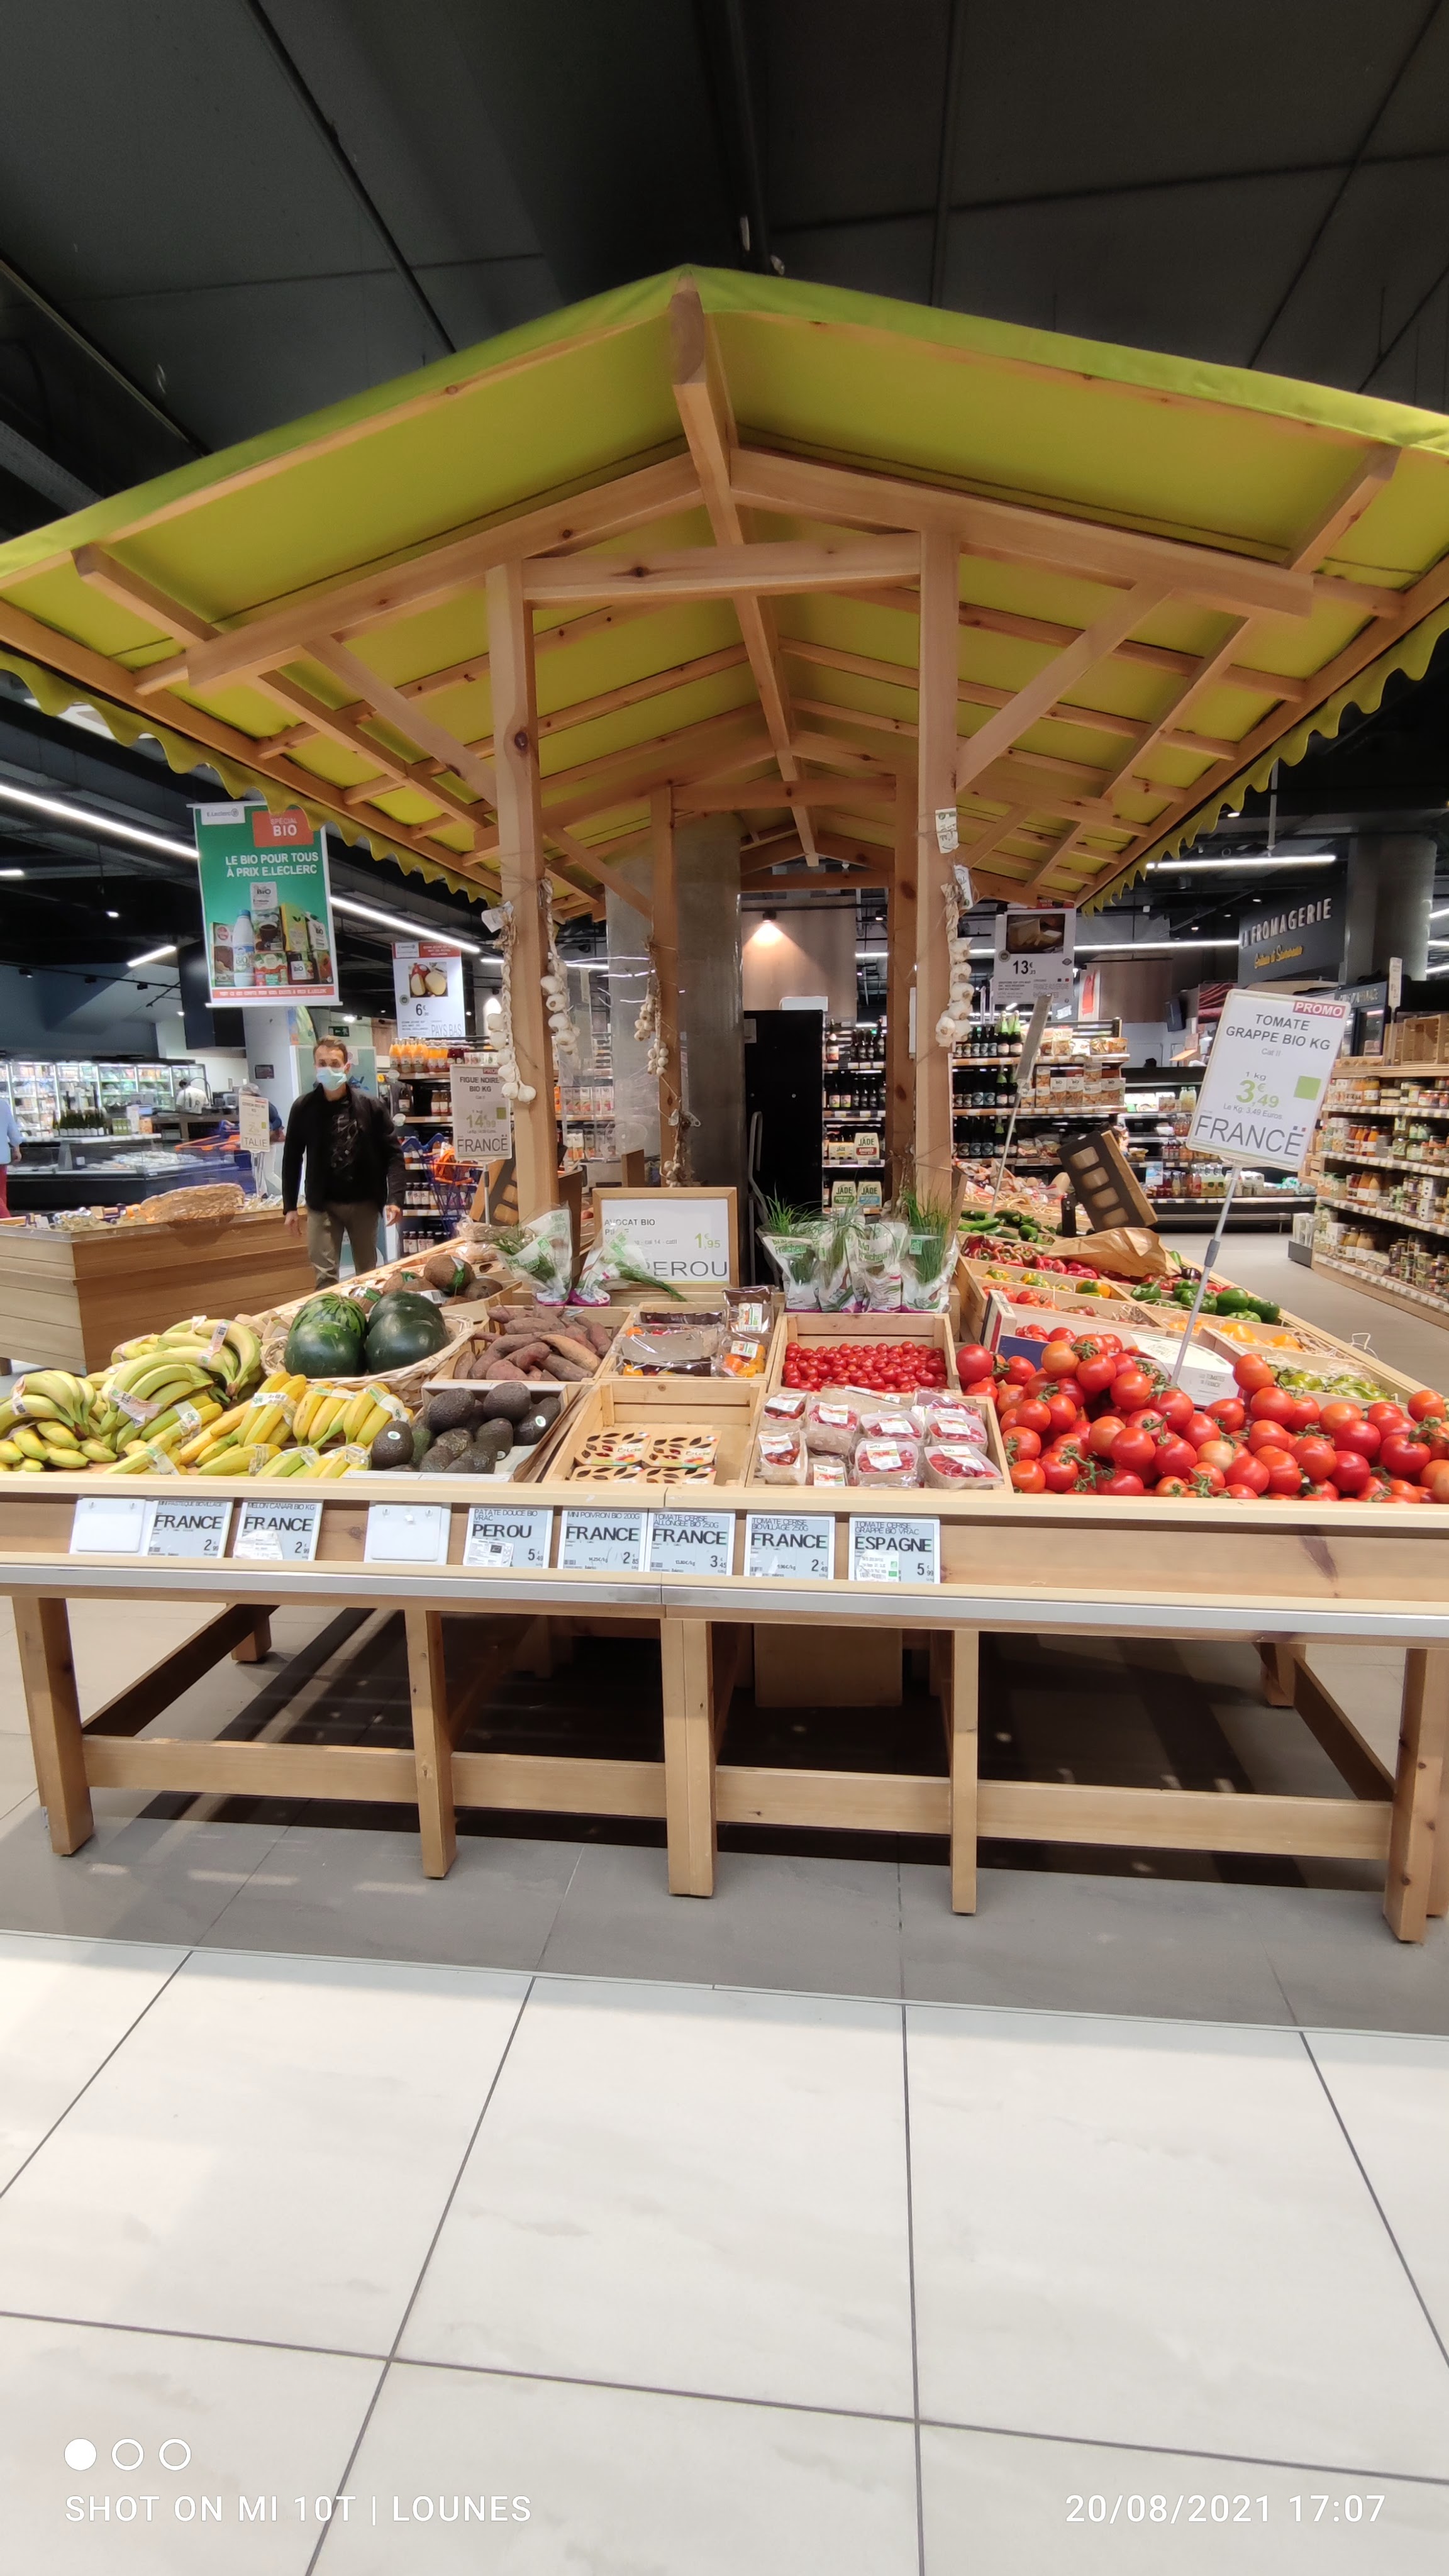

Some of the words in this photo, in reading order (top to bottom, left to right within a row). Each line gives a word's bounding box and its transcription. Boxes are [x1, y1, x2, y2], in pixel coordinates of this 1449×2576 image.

[273, 824, 297, 837] BIO
[225, 855, 238, 865] LE
[240, 854, 258, 865] BIO
[260, 853, 289, 864] POUR
[291, 852, 319, 862] TOUS
[226, 866, 235, 877] À
[236, 867, 259, 877] PRIX
[262, 864, 317, 877] E.LECLERC
[1251, 897, 1332, 943] FROMAGERIE
[1294, 1001, 1343, 1018] PROMO
[431, 1024, 448, 1036] PAYS
[449, 1023, 462, 1036] BAS
[1255, 1014, 1311, 1031] TOMATE
[1226, 1026, 1279, 1043] GRAPPE
[1282, 1032, 1306, 1047] BIO
[1309, 1036, 1331, 1050] KG
[1261, 1048, 1275, 1057] Cat
[1253, 1072, 1267, 1082] kg
[858, 1138, 875, 1146] JADE
[1195, 1115, 1304, 1157] FRANCE
[457, 1138, 508, 1153] FRANCE
[836, 1187, 852, 1195] JADE
[861, 1187, 878, 1195] JADE
[645, 1260, 728, 1277] EROU
[153, 1514, 224, 1530] FRANCE
[243, 1516, 314, 1532] FRANCE
[654, 1513, 682, 1521] TOMATE
[472, 1524, 532, 1538] PEROU
[565, 1526, 640, 1541] FRANCE
[652, 1528, 728, 1545] FRANCE
[203, 1539, 212, 1551] 2
[294, 1541, 303, 1553] 2
[751, 1532, 828, 1549] FRANCE
[855, 1536, 932, 1552] ESPAGNE
[528, 1548, 535, 1561] 5
[623, 1551, 630, 1564] 2
[709, 1555, 718, 1568] 3
[811, 1558, 819, 1572] 2
[917, 1562, 924, 1576] 5
